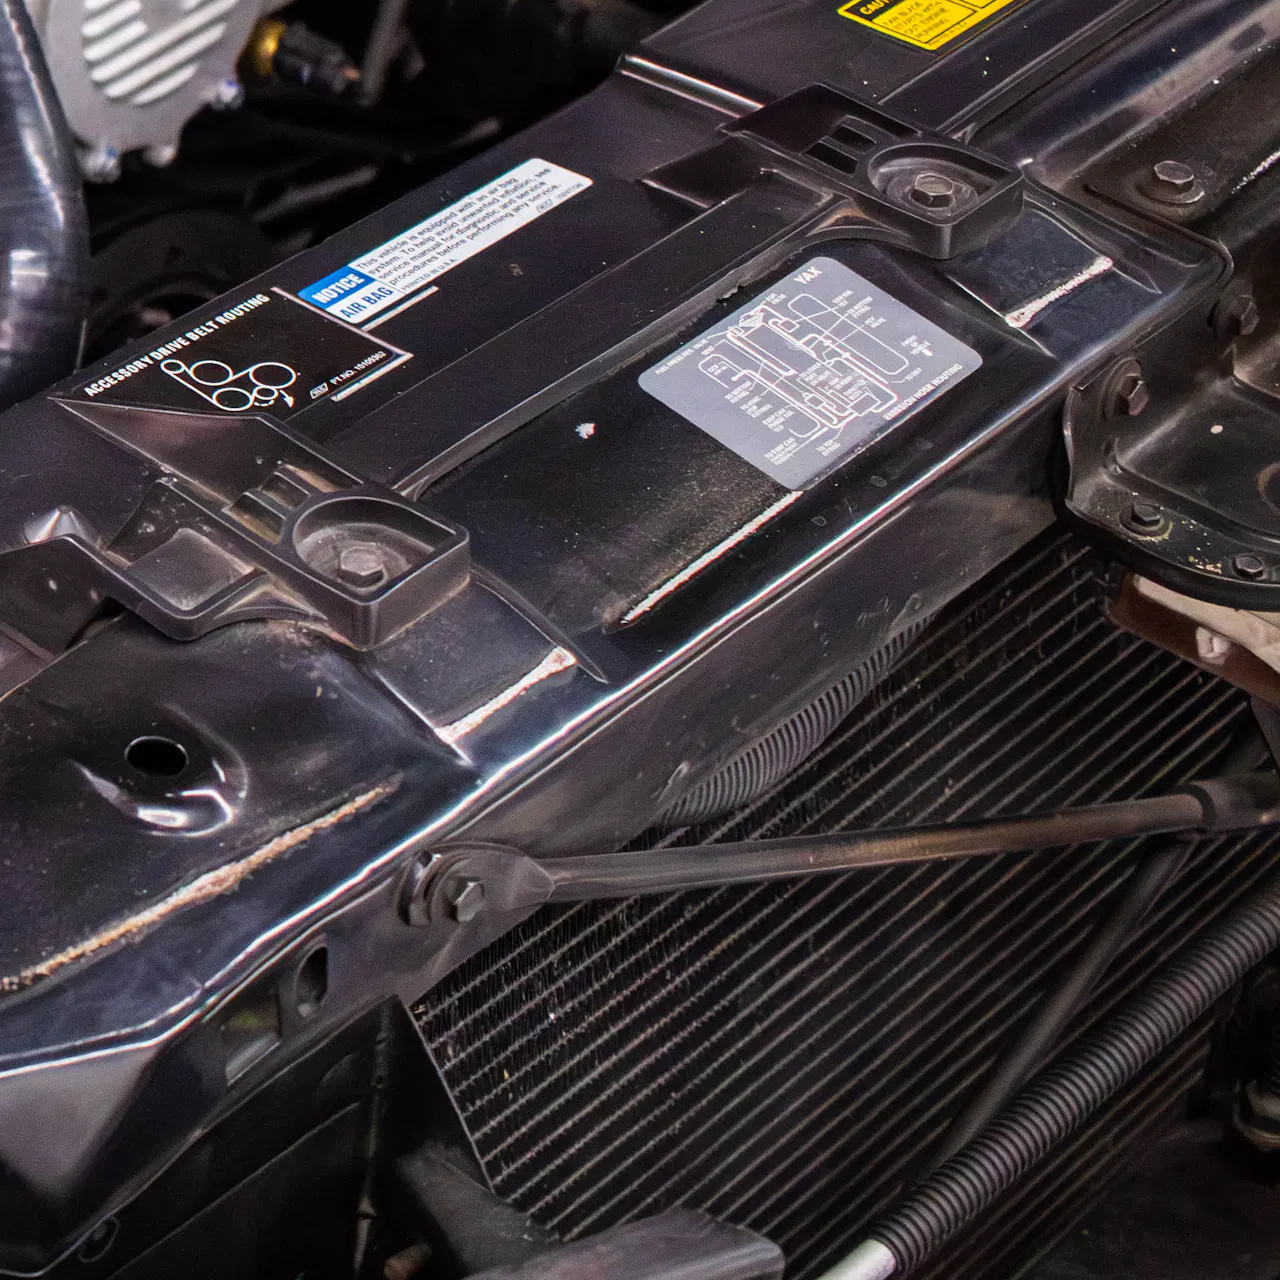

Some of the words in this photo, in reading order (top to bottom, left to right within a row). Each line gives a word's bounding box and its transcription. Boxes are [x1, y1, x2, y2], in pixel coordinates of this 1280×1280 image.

[355, 257, 380, 270] This
[374, 239, 411, 259] vehicle
[414, 211, 459, 236] equipped
[453, 200, 478, 213] with
[472, 193, 490, 202] an
[483, 186, 502, 195] air
[495, 176, 519, 188] bag
[366, 253, 404, 275] system.
[400, 246, 417, 255] To
[411, 235, 437, 248] help
[431, 221, 460, 236] avoid
[454, 197, 501, 223] unwanted
[531, 167, 553, 178] see
[376, 260, 412, 280] service
[407, 241, 445, 262] manual
[439, 233, 458, 243] for
[452, 208, 500, 235] diagnostic
[495, 198, 517, 210] and
[513, 180, 548, 199] service
[387, 254, 441, 286] procedures
[435, 238, 469, 257] before
[463, 211, 515, 240] performing
[508, 201, 532, 213] any
[526, 182, 564, 203] service.
[309, 272, 366, 304] NOTICE
[337, 301, 369, 319] AIR
[360, 285, 395, 305] BAG
[792, 265, 823, 286] YAX
[80, 355, 158, 396] ACCESSORY
[146, 336, 192, 360] DRIVE
[182, 319, 222, 341] BELT
[211, 292, 272, 324] ROUTING
[880, 395, 918, 420] EMISSION
[911, 382, 936, 399] HOSE
[929, 362, 965, 386] ROUTING
